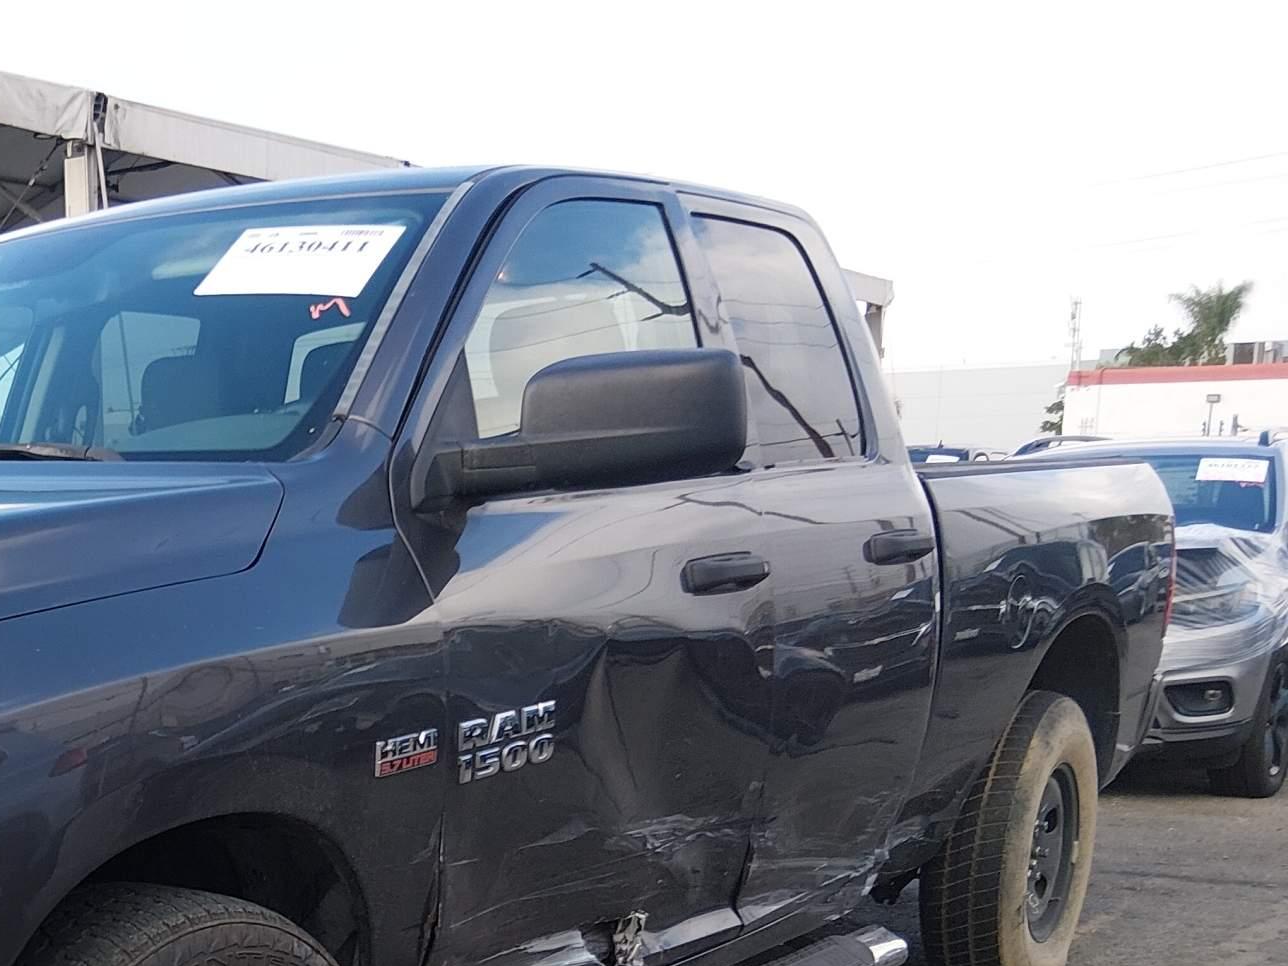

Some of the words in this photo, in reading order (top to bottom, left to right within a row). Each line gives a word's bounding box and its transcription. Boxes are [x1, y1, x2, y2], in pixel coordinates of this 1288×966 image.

[244, 240, 371, 254] 46130411
[458, 700, 556, 751] RAM
[457, 733, 555, 784] 1500
